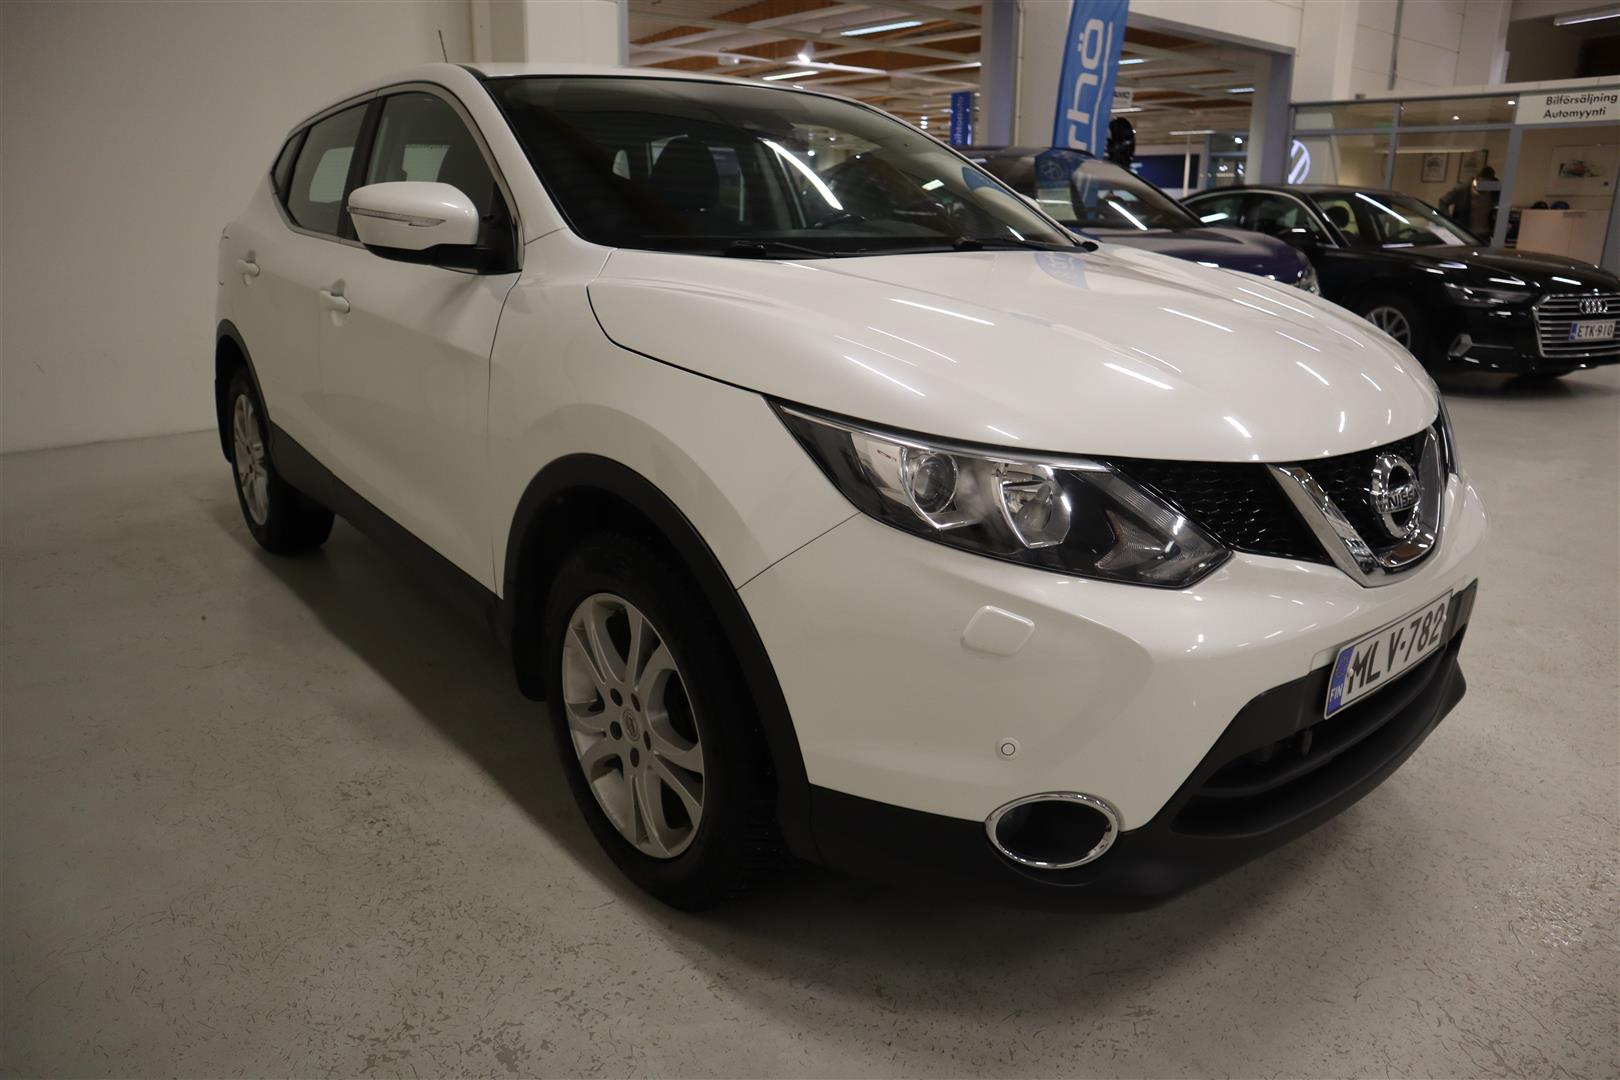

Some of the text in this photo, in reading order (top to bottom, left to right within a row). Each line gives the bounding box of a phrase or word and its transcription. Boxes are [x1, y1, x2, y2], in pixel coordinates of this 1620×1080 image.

[1546, 92, 1618, 106] Bilförsäljning
[1543, 106, 1607, 119] Automyynti
[1577, 323, 1615, 338] ETK-910
[1347, 602, 1446, 695] MLV-782
[1329, 683, 1344, 703] FIN
